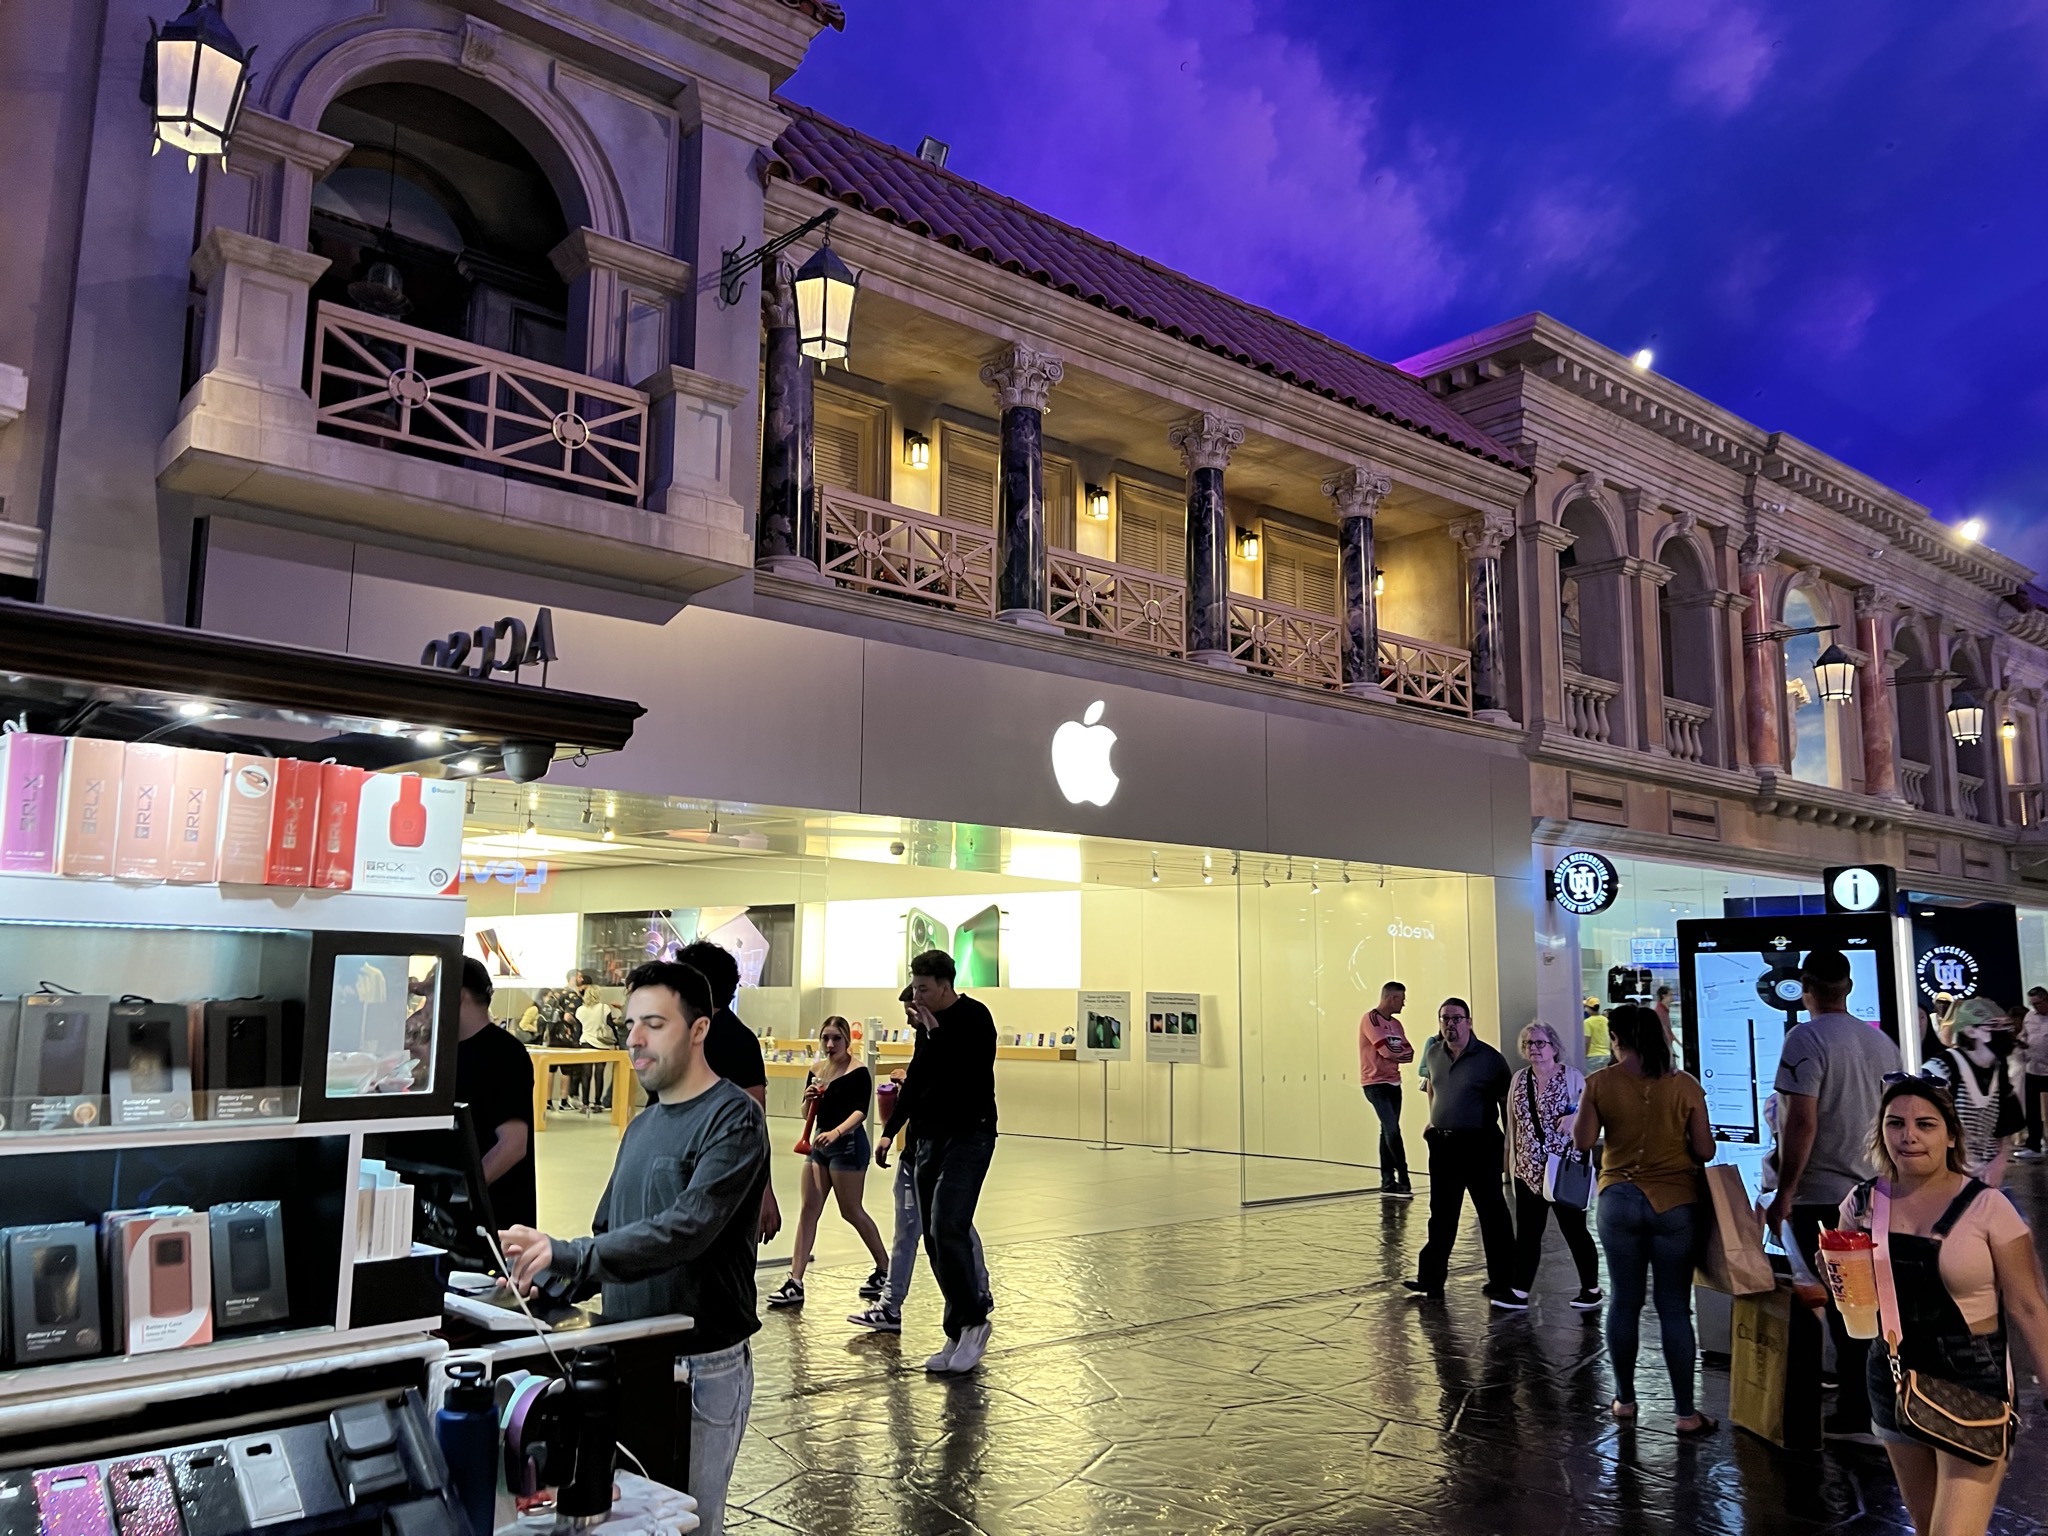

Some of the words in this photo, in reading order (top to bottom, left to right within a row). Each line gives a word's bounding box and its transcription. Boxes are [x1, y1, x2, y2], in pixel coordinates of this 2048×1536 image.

[136, 784, 153, 826] RLX
[187, 789, 203, 829] RLX
[377, 861, 405, 874] RLX
[1917, 951, 1934, 974] URBAN
